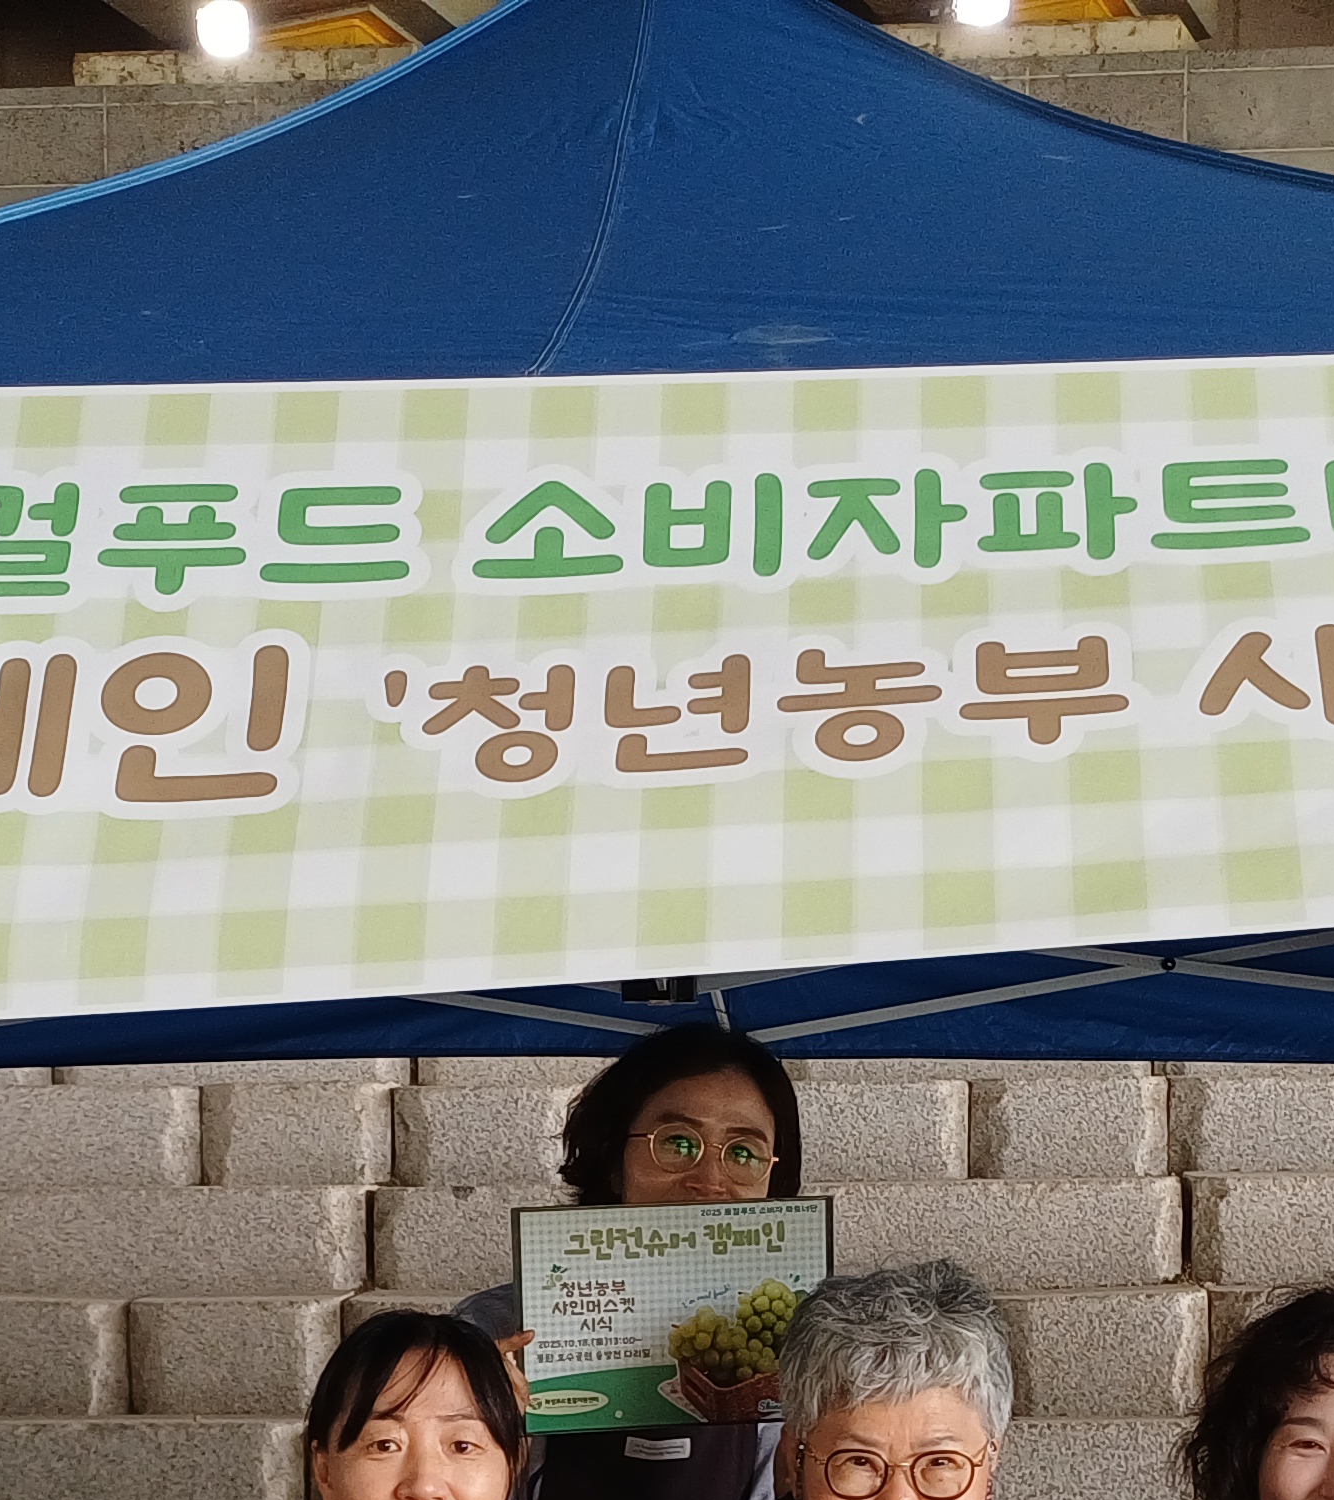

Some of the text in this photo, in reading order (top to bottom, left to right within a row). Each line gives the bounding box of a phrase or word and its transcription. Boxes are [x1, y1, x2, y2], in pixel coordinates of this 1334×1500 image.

[384, 633, 1130, 785] '청년농부
[563, 1219, 786, 1261] 그린컨슈머 캠페인
[559, 1280, 627, 1298] 청년농부
[551, 1298, 636, 1316] 샤인머스켓
[579, 1316, 614, 1333] 시식
